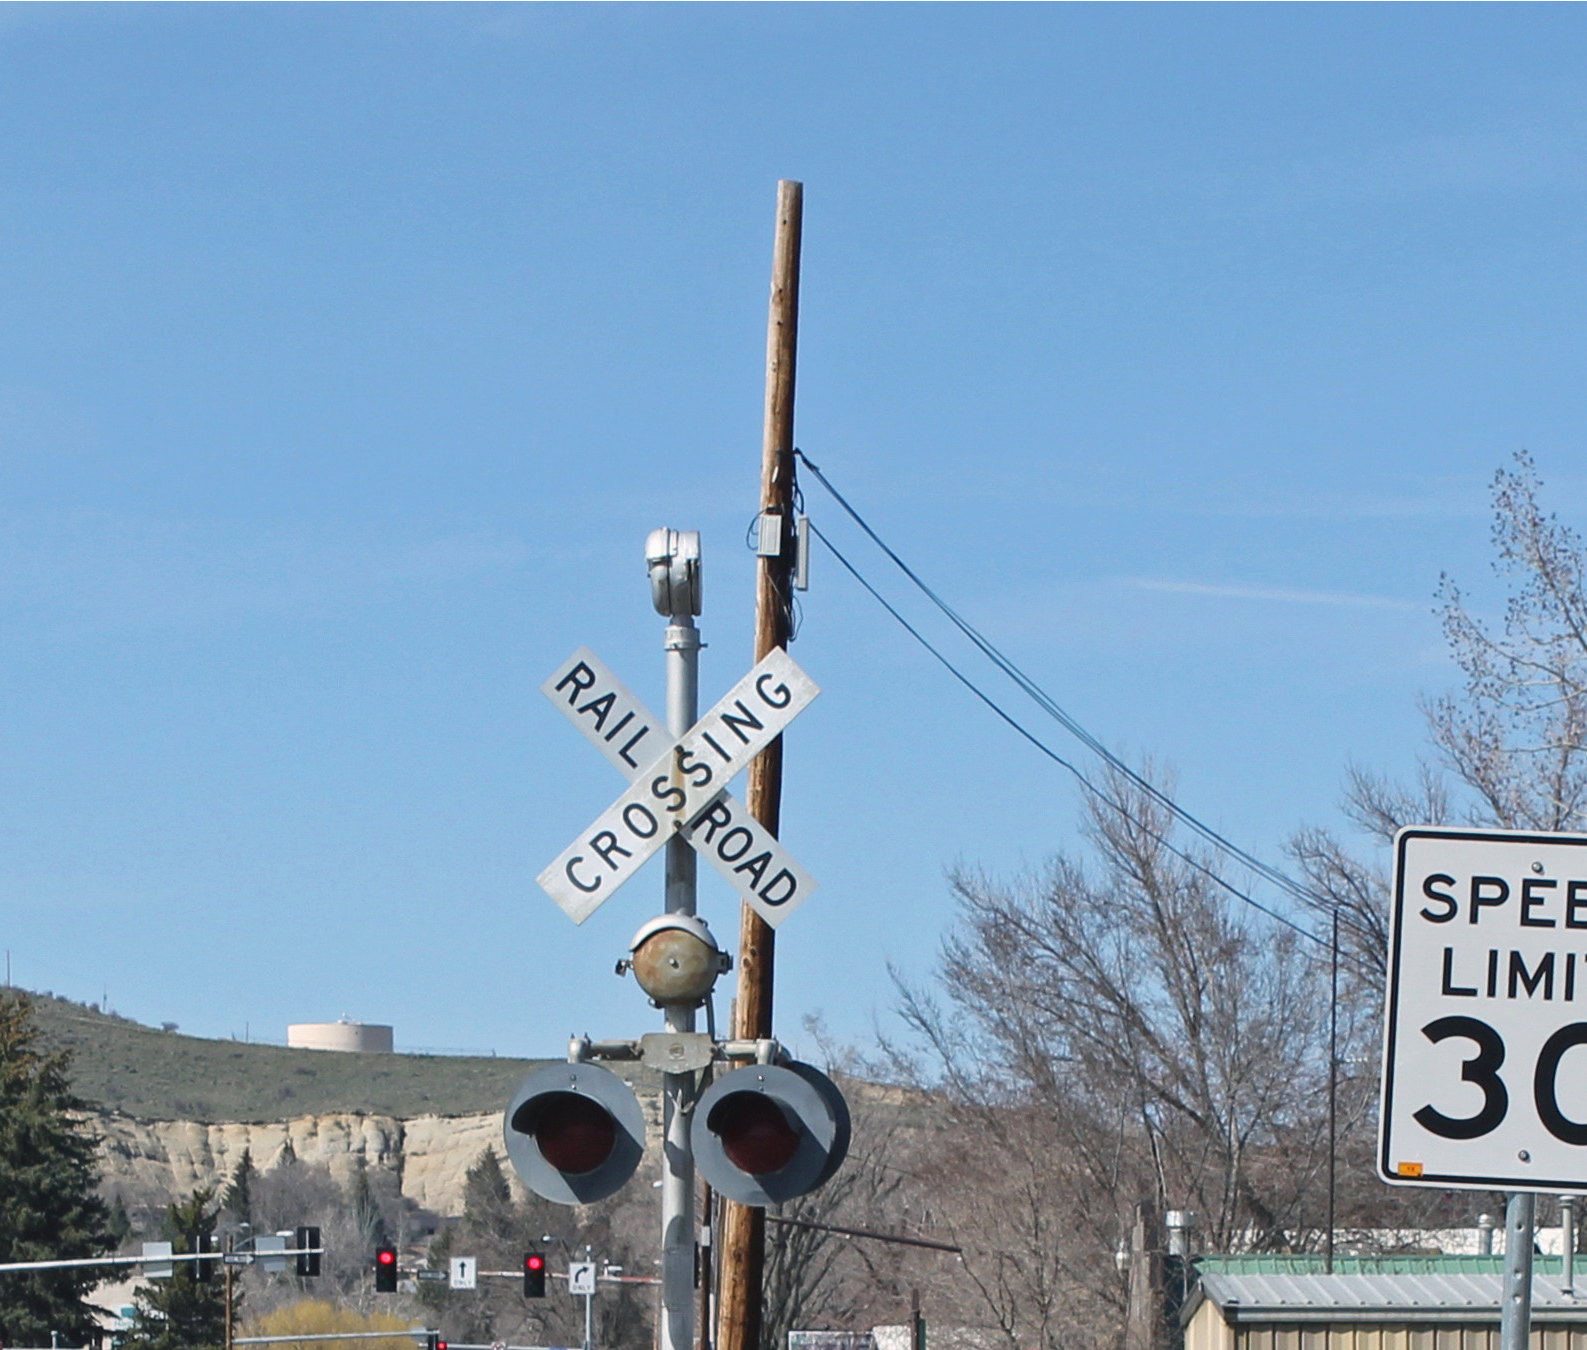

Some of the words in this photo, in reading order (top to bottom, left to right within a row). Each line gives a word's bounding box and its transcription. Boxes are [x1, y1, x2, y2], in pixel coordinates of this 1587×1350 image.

[555, 661, 649, 769] RAIL
[565, 673, 791, 893] CROSSING
[691, 799, 797, 907] ROAD
